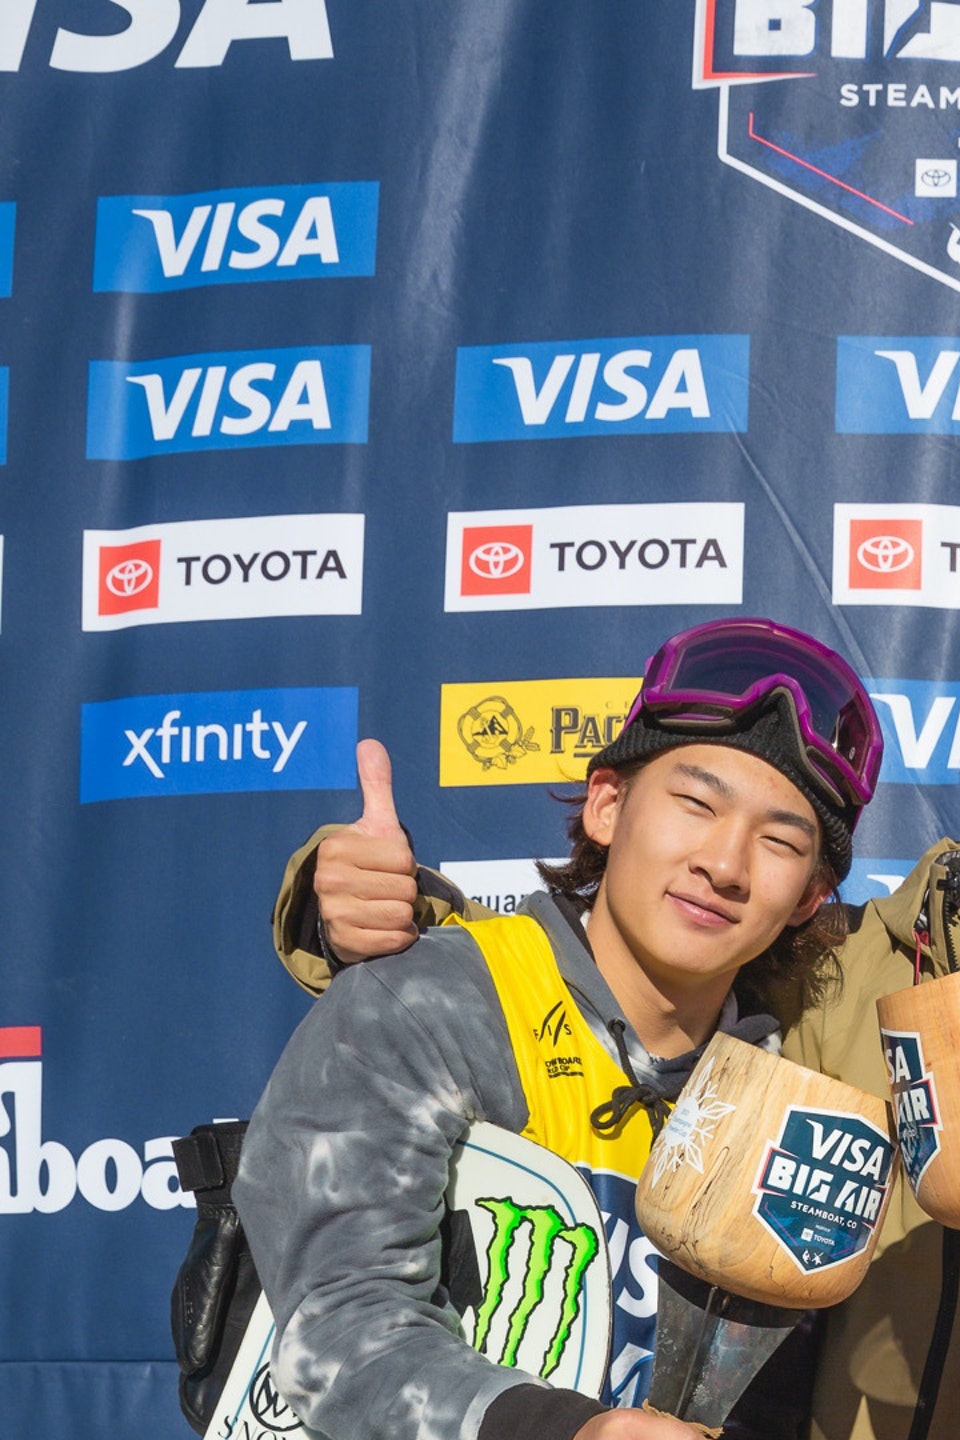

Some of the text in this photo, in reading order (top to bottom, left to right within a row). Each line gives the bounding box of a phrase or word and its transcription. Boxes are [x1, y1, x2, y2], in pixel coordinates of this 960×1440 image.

[132, 196, 340, 278] VISA
[126, 360, 332, 441] VISA
[492, 349, 710, 425] VISA
[177, 549, 347, 587] TOYOTA
[549, 537, 728, 572] TOYOTA
[122, 708, 308, 779] xfinity
[806, 1119, 885, 1181] VISA
[767, 1156, 883, 1222] BIG AIR
[790, 1201, 845, 1227] STEAMBOAT,
[847, 1219, 858, 1230] CO
[813, 1233, 836, 1247] TOYOTA
